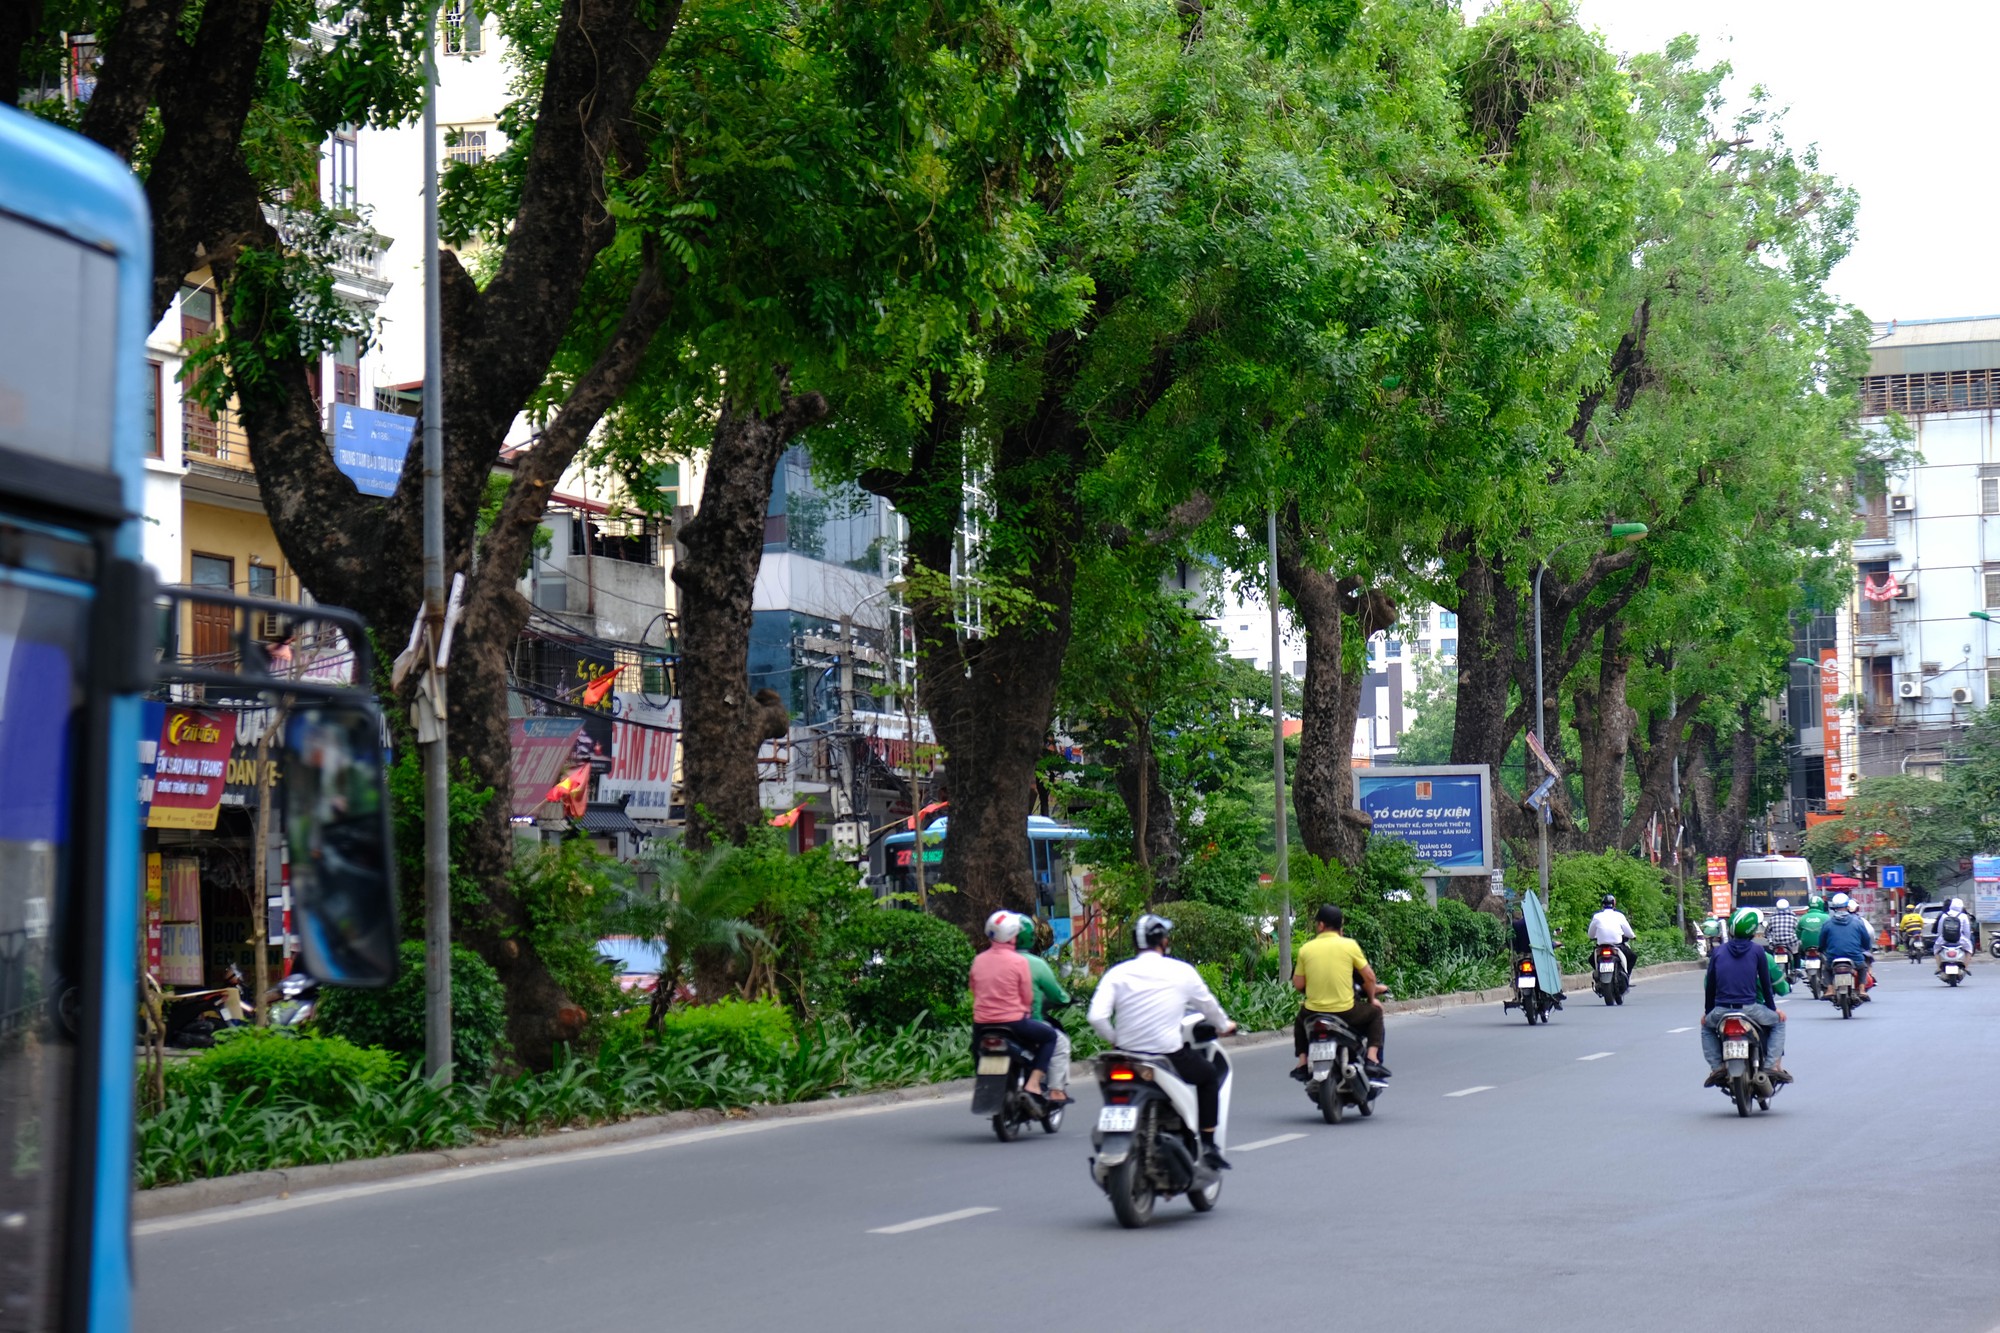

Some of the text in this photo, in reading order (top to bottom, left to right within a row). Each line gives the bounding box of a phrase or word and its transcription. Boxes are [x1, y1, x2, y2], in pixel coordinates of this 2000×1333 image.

[199, 759, 224, 778] TRANG
[1373, 805, 1471, 820] TỔ CHỨC SỰ KIỆN
[1373, 822, 1394, 830] CHUYÊN
[1395, 821, 1411, 829] THIẾT
[1449, 820, 1464, 828] THIẾT
[1419, 843, 1440, 851] QUẢNG
[896, 849, 912, 866] 27
[1432, 849, 1453, 858] 3333
